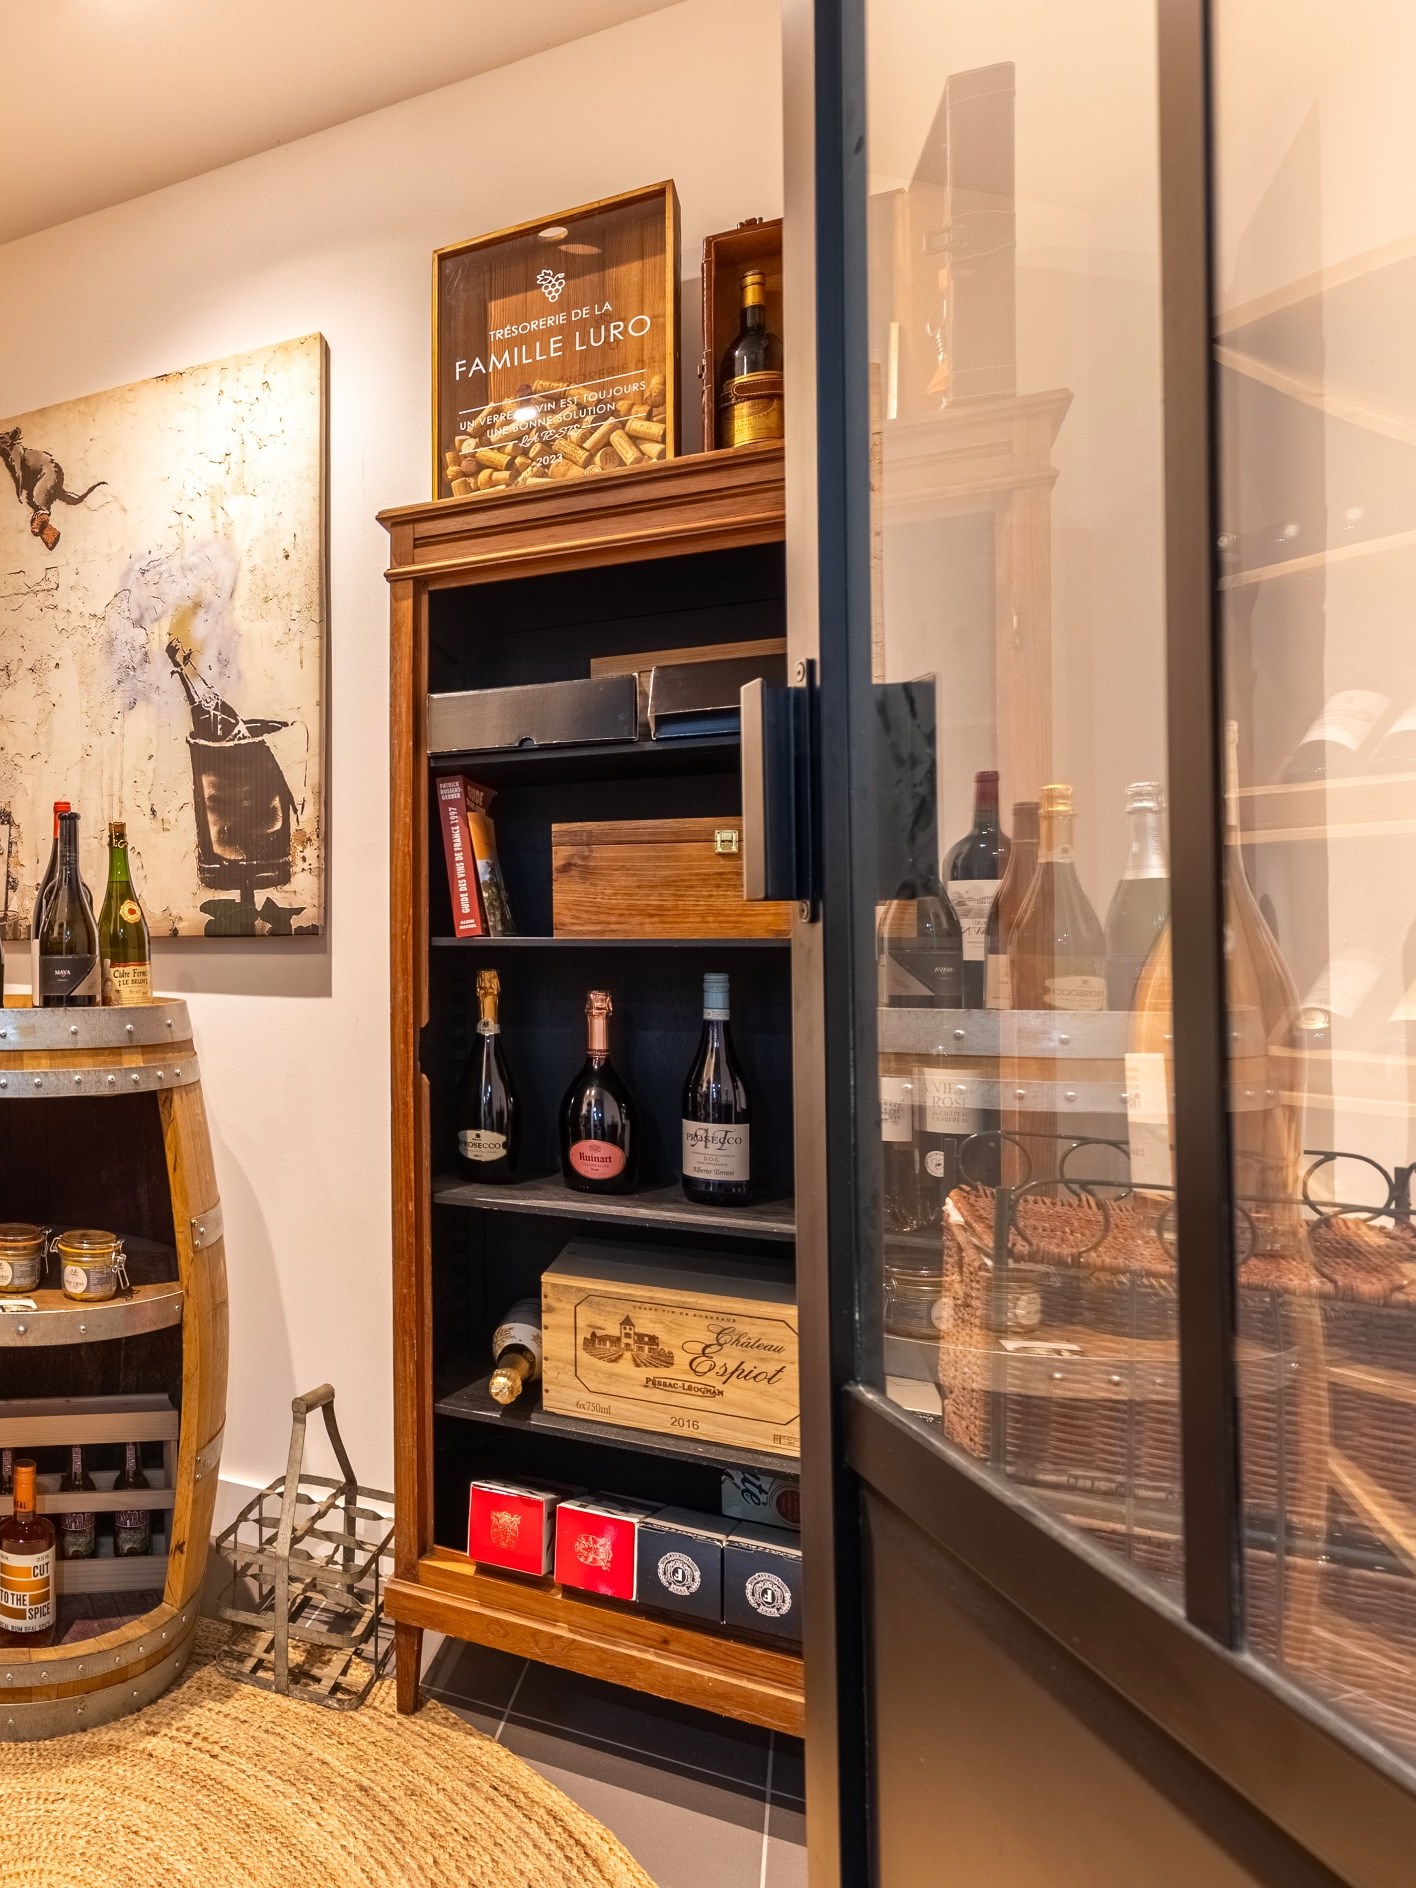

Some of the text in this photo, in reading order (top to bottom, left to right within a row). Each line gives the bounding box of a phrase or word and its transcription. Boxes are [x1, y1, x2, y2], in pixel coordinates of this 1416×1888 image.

[489, 302, 613, 342] TRÉSORERIE DE LA
[455, 315, 651, 381] FAMILLE LURO
[460, 420, 475, 431] UN
[480, 412, 513, 426] VERRE
[536, 402, 556, 413] VIN
[561, 396, 579, 407] EST
[582, 381, 646, 404] TOUJOURS
[486, 426, 509, 438] UNE
[513, 416, 553, 432] BONNE
[556, 403, 616, 422] SOLUTION
[536, 454, 563, 467] 2023
[439, 781, 460, 789] PATRICK
[448, 807, 471, 914] GUIDE DES VINS DE FRANCE 1997
[460, 1140, 501, 1150] PROSECCO
[686, 1132, 742, 1145] PROSECCO
[578, 1151, 612, 1164] Ruinart
[692, 1166, 712, 1174] Alberto
[706, 1323, 786, 1354] Château
[681, 1340, 787, 1385] Espiot
[576, 1400, 612, 1415] 6x750ml
[670, 1416, 700, 1431] 2016
[32, 1561, 50, 1578] CUT
[0, 1588, 27, 1607] TO THE
[28, 1602, 51, 1620] SPICE
